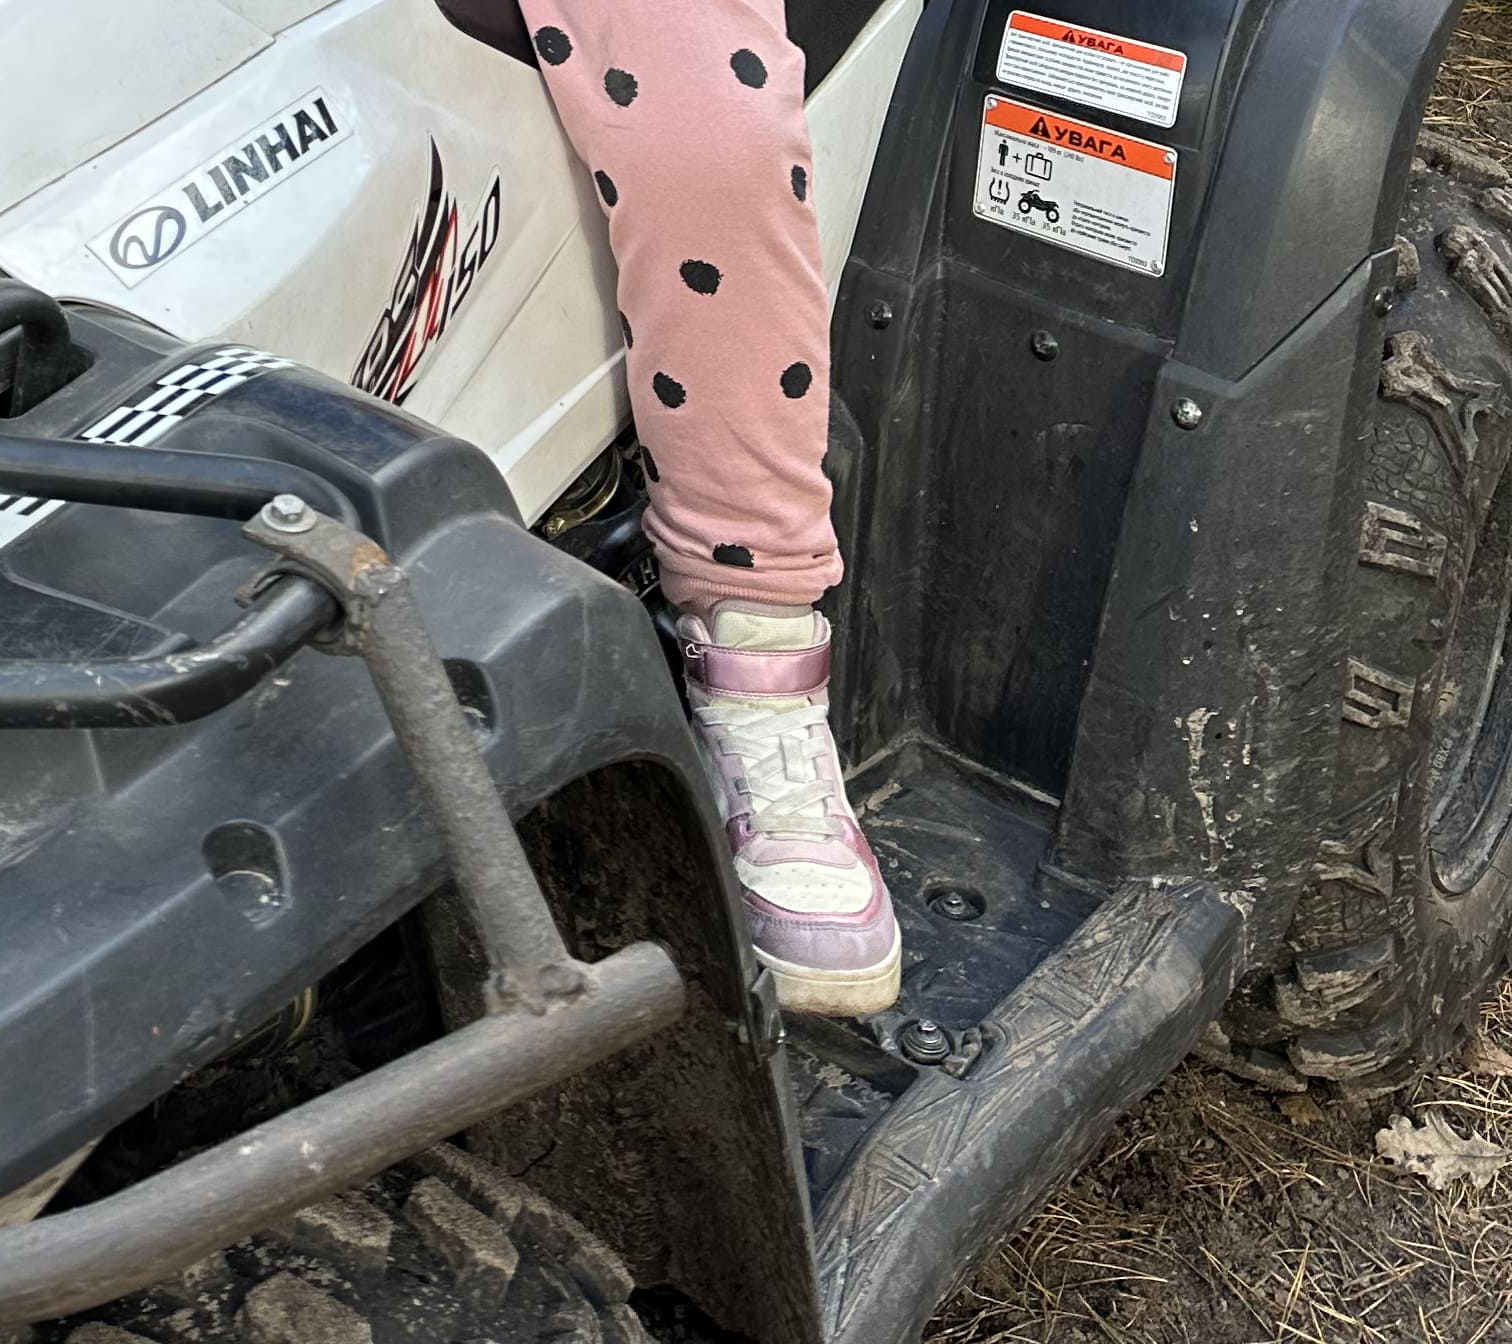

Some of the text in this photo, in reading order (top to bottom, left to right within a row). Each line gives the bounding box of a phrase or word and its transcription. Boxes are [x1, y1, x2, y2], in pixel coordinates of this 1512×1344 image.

[1078, 33, 1124, 55] УВАГА
[182, 97, 339, 223] LINHAI
[1054, 126, 1127, 161] УВАГА
